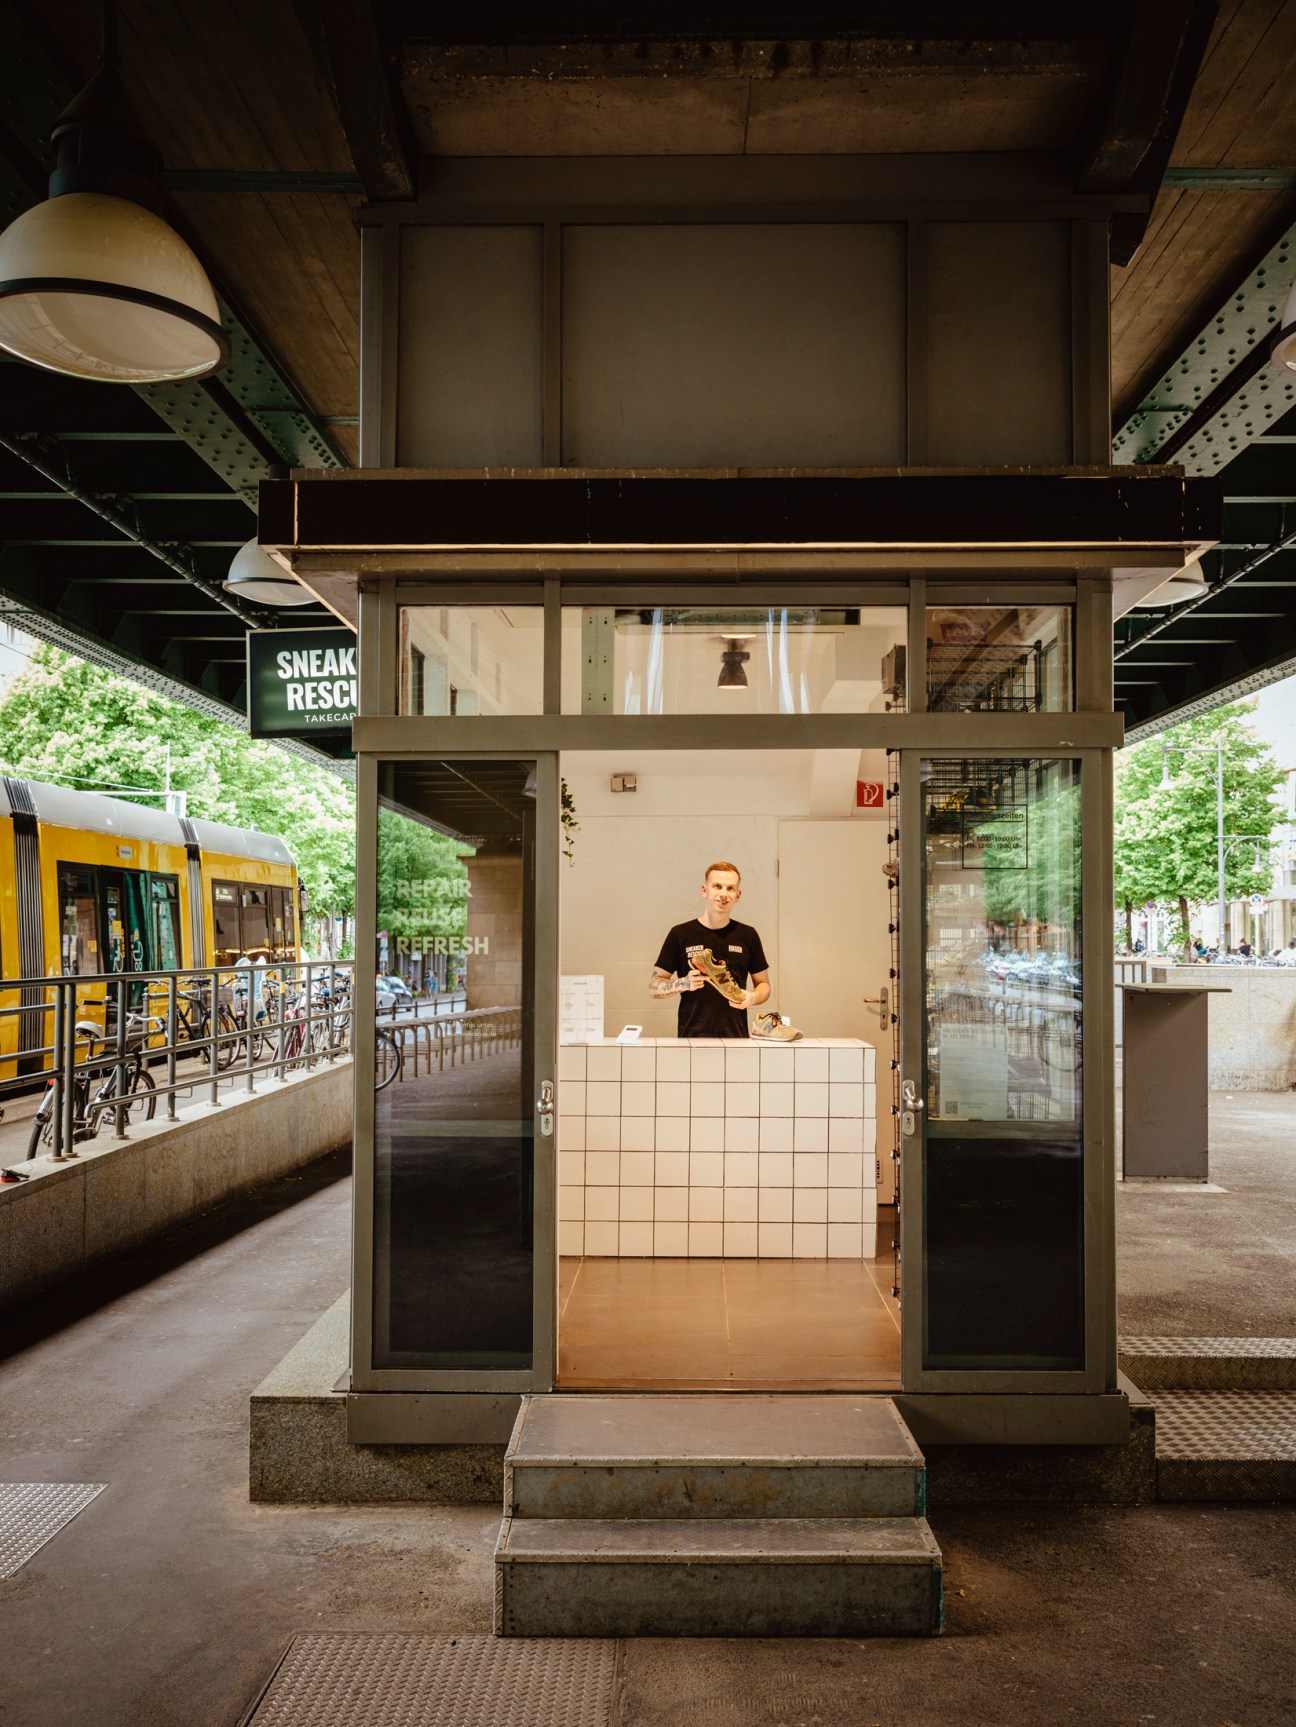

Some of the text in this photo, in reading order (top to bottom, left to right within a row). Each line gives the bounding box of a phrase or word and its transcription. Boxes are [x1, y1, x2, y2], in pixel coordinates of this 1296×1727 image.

[276, 648, 357, 679] SNEAK
[397, 879, 473, 898] REPAIR
[397, 908, 464, 926] REUSE
[396, 936, 489, 955] REFRESH
